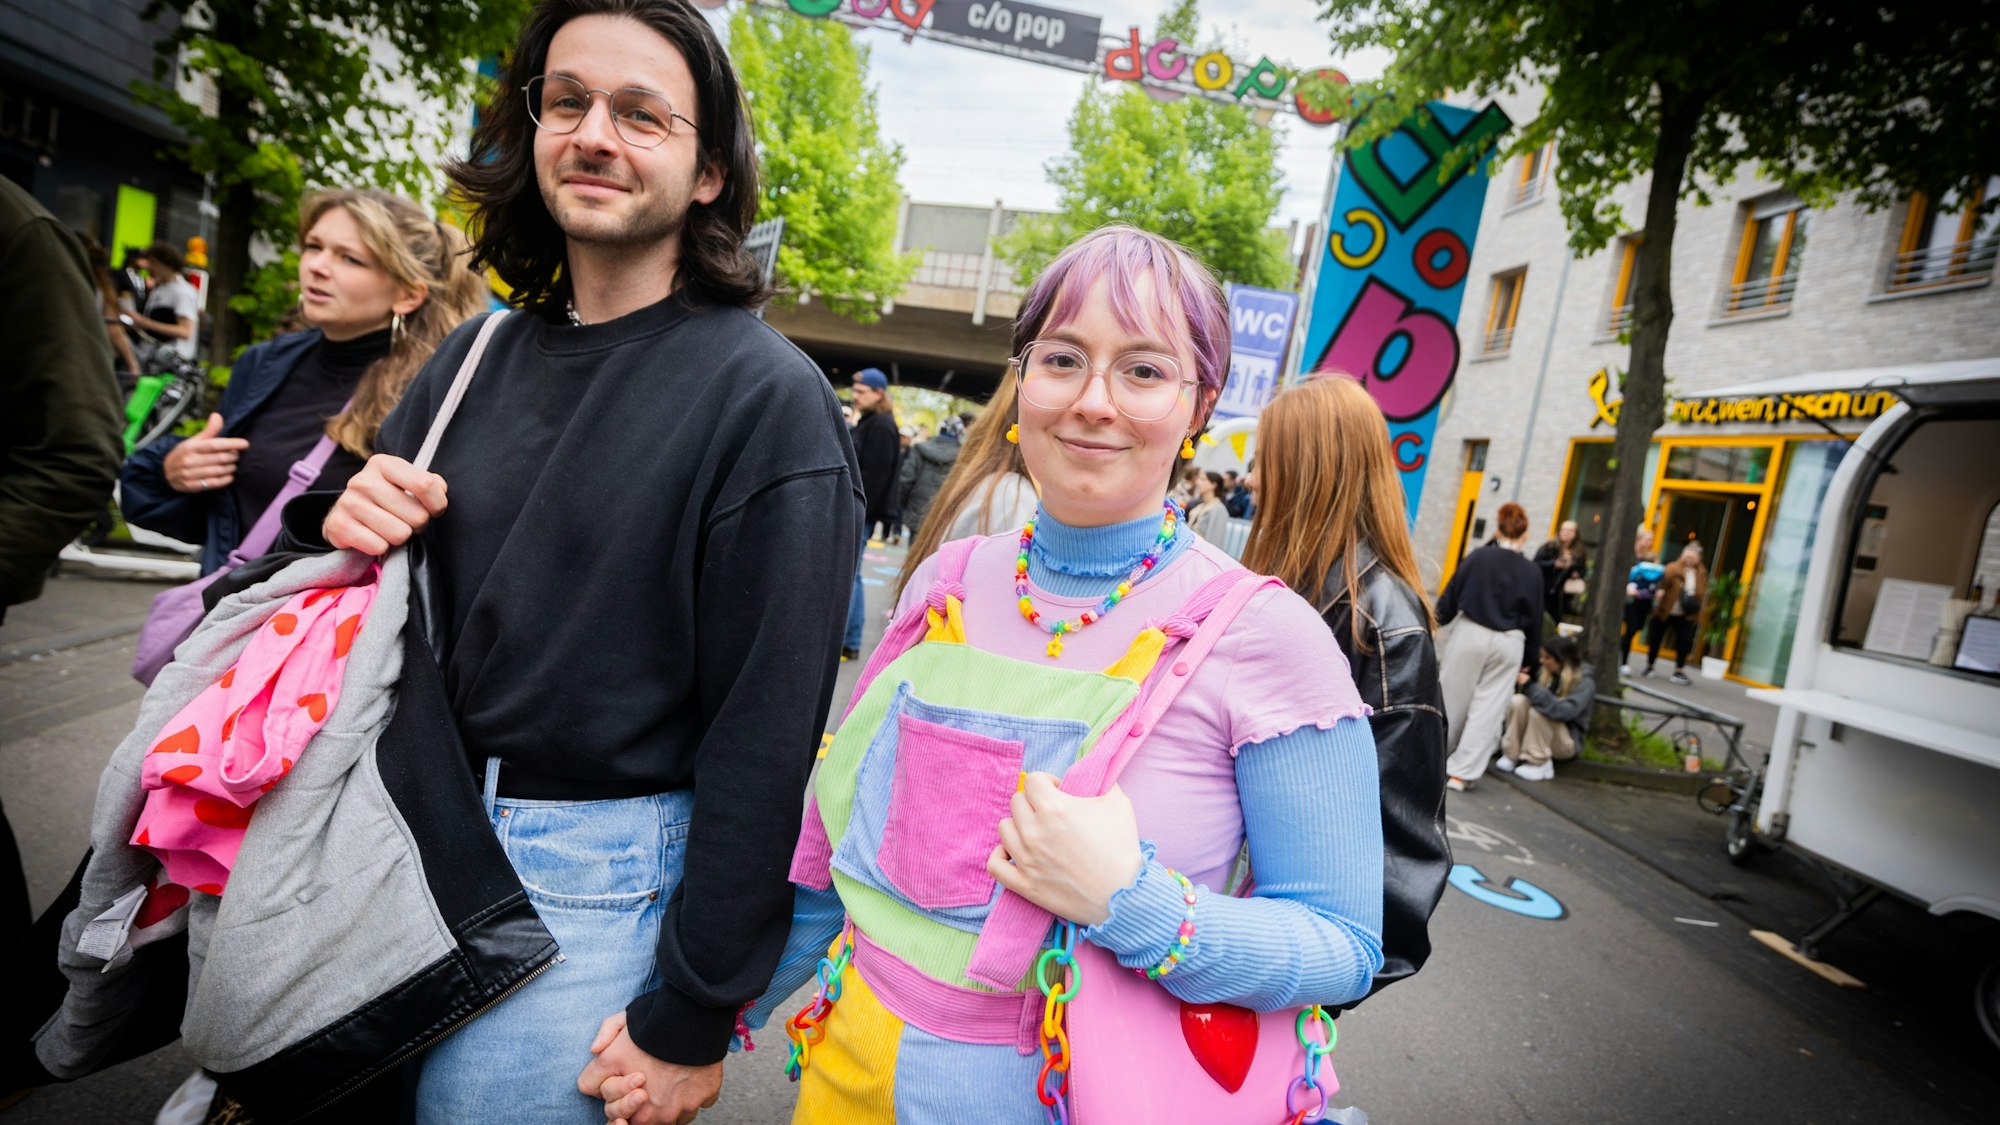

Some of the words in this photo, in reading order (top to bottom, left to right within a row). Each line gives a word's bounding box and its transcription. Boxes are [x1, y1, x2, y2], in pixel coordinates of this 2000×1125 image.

[968, 1, 1012, 33] c/o
[1013, 12, 1066, 48] pop
[1233, 306, 1285, 340] WC
